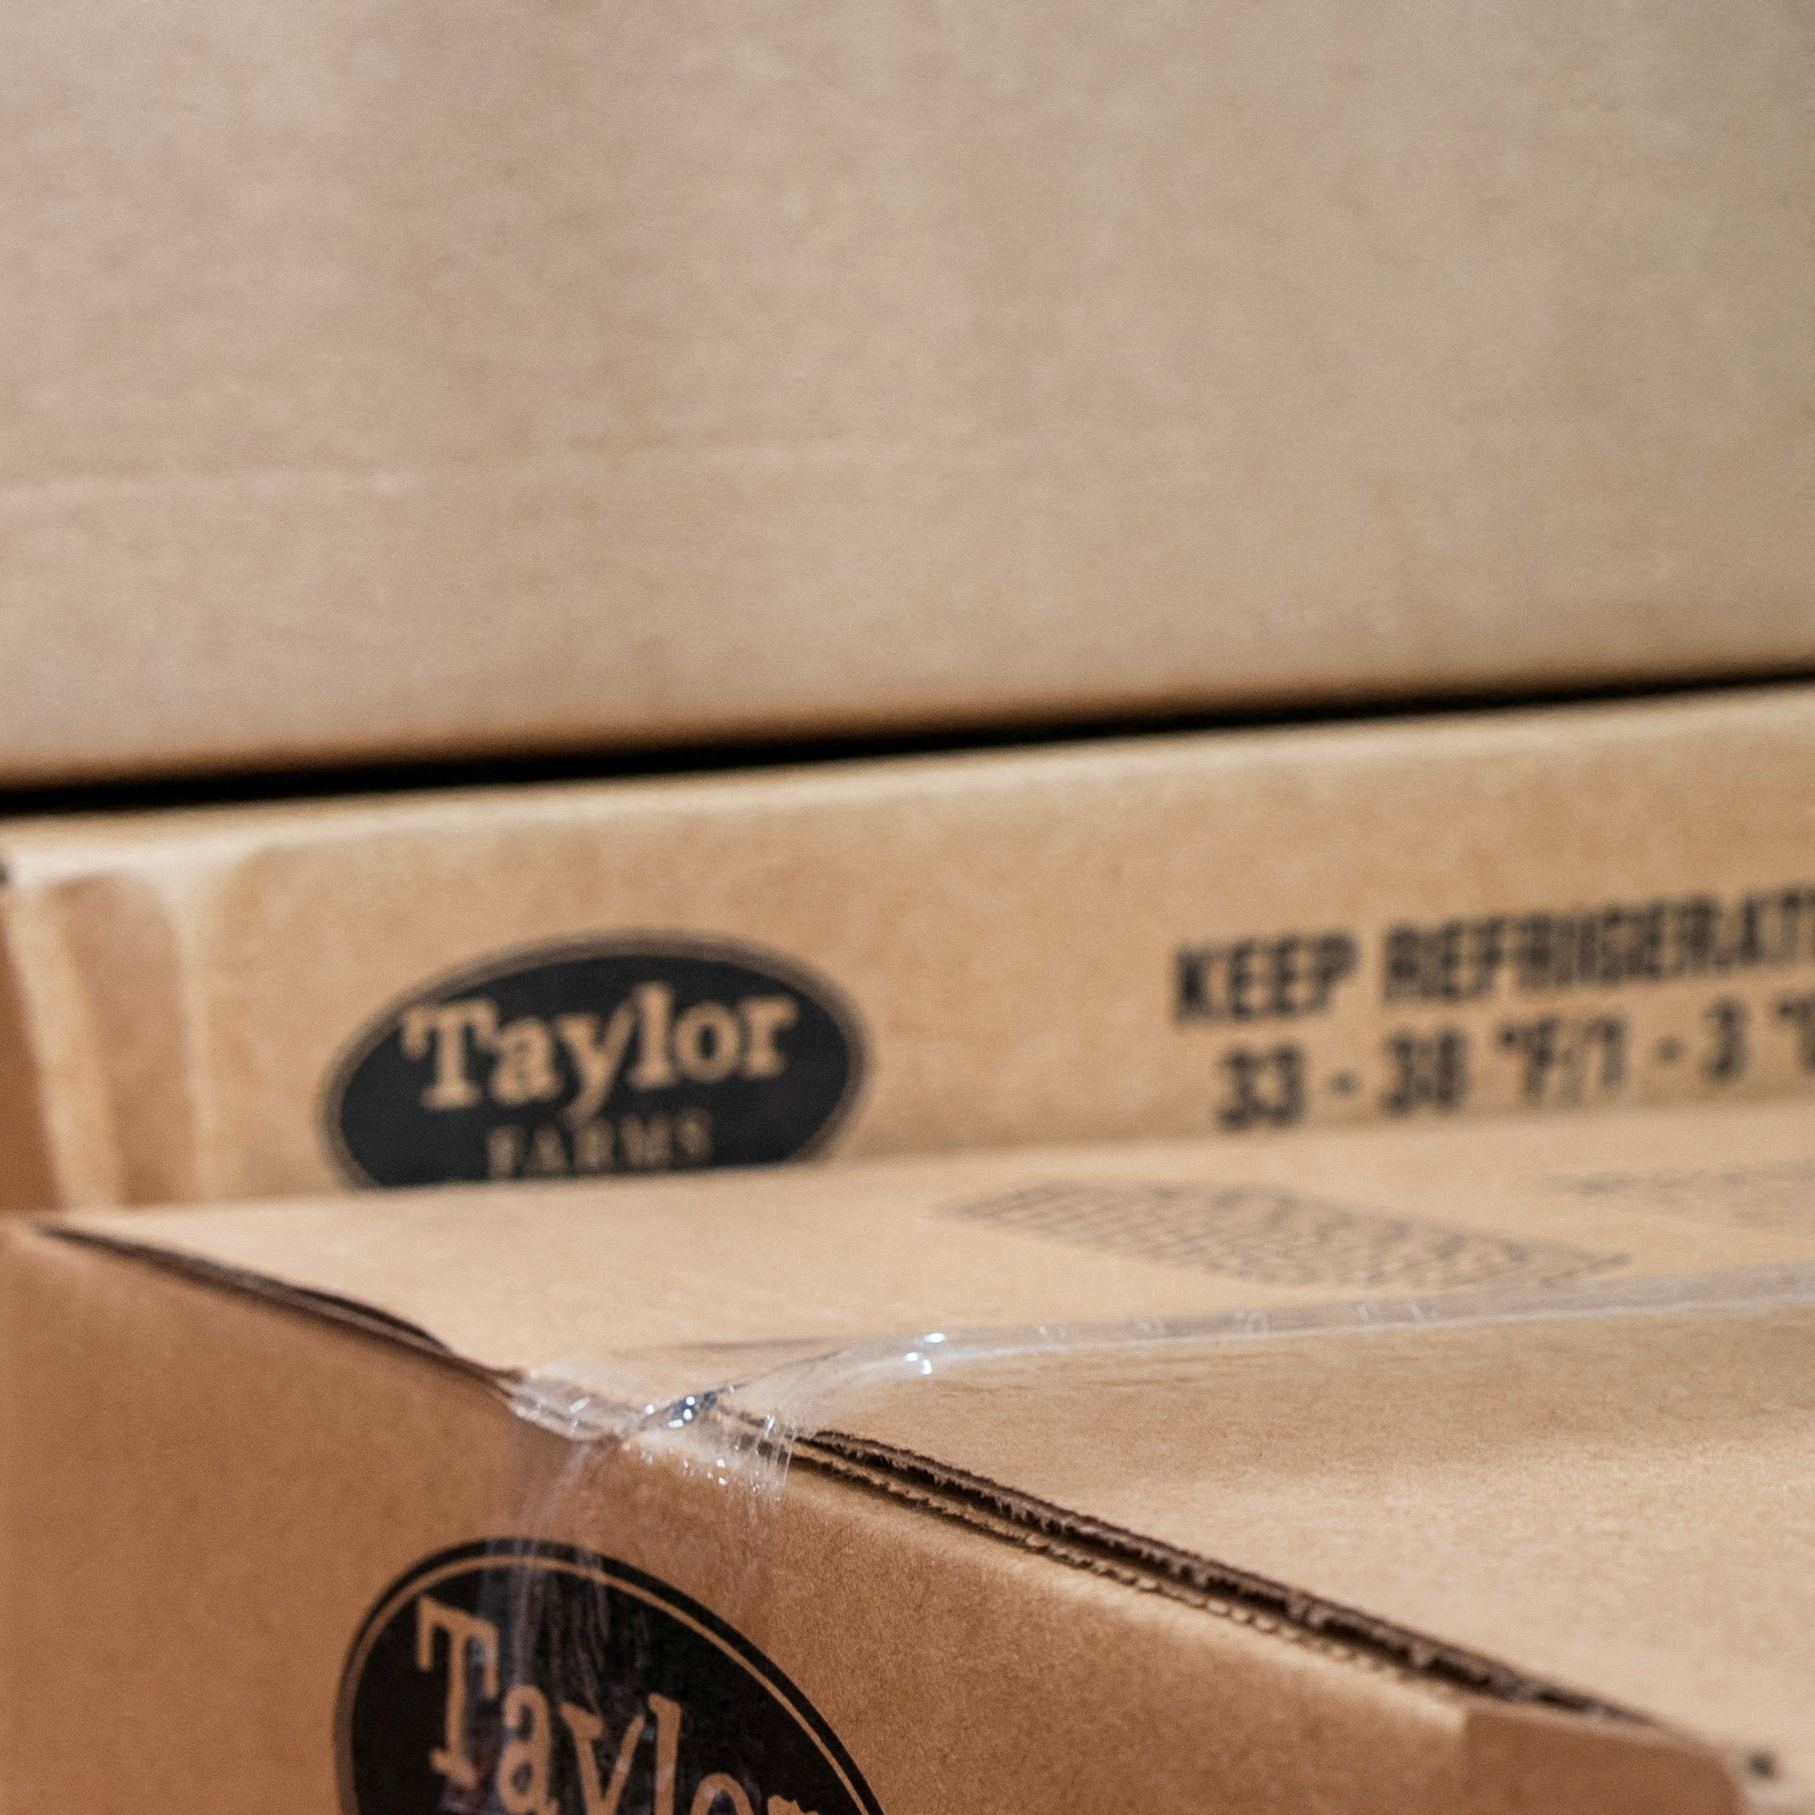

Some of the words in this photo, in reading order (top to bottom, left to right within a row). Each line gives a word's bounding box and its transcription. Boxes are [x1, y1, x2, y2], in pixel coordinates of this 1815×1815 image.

[1175, 930, 1357, 1026] KEEP
[1383, 884, 1815, 1003] REFRIGERAT
[400, 982, 798, 1122] Taylor
[1219, 1043, 1302, 1132] 33
